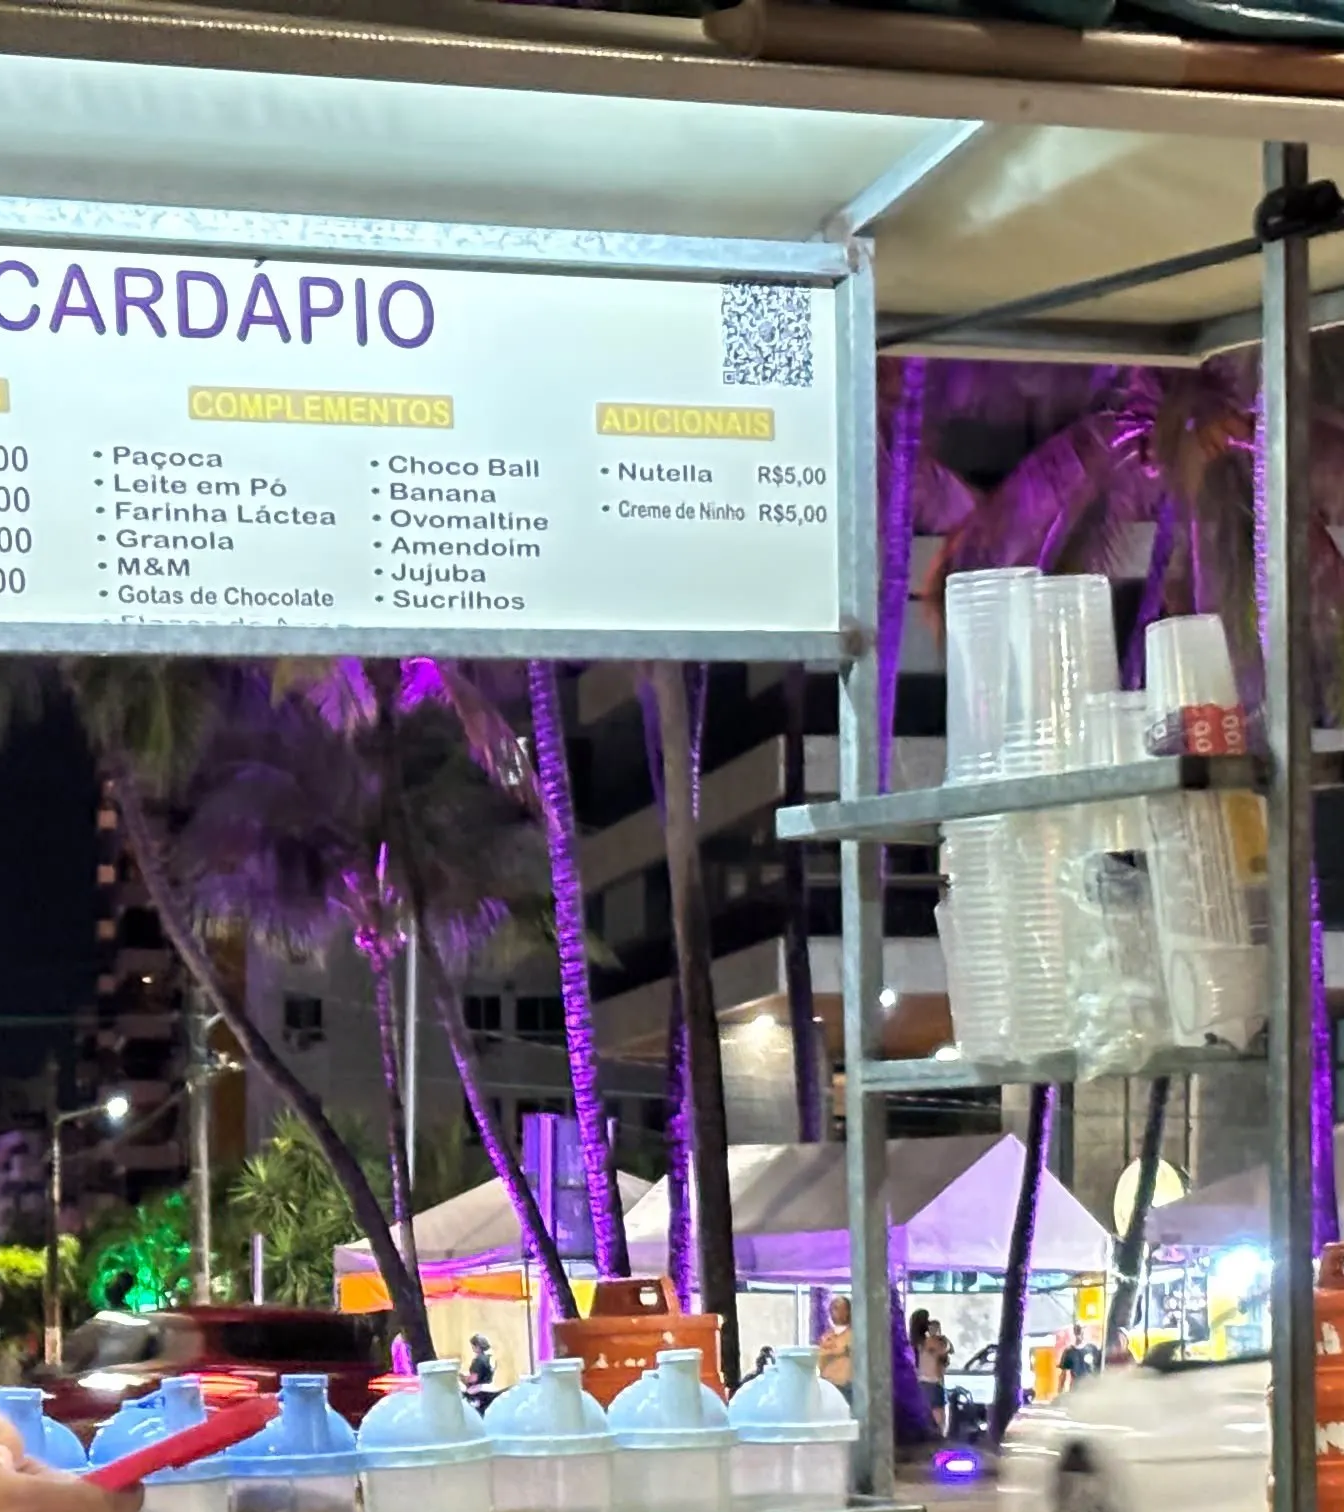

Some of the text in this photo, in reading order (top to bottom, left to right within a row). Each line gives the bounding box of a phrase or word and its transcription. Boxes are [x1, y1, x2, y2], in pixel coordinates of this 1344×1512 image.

[191, 391, 452, 426] COMPLEMENTOS
[602, 408, 770, 438] ADICIONAIS
[113, 446, 223, 471] Paçoca
[388, 455, 540, 479] Choco Ball
[113, 473, 287, 498] Leite em Pó
[618, 462, 827, 488] Nutella R$5,00
[389, 482, 497, 503] Banana
[115, 501, 336, 526] Farinha Láctea
[390, 509, 549, 531] Ovomaltine
[618, 499, 828, 527] Creme de Ninho R$5,00
[115, 528, 234, 551] Granola
[390, 536, 541, 558] Amendoim
[117, 556, 190, 577] M&M
[390, 563, 486, 587] Jujuba
[117, 584, 334, 607] Gotas de Chocolate
[393, 589, 525, 611] Sucrilhos
